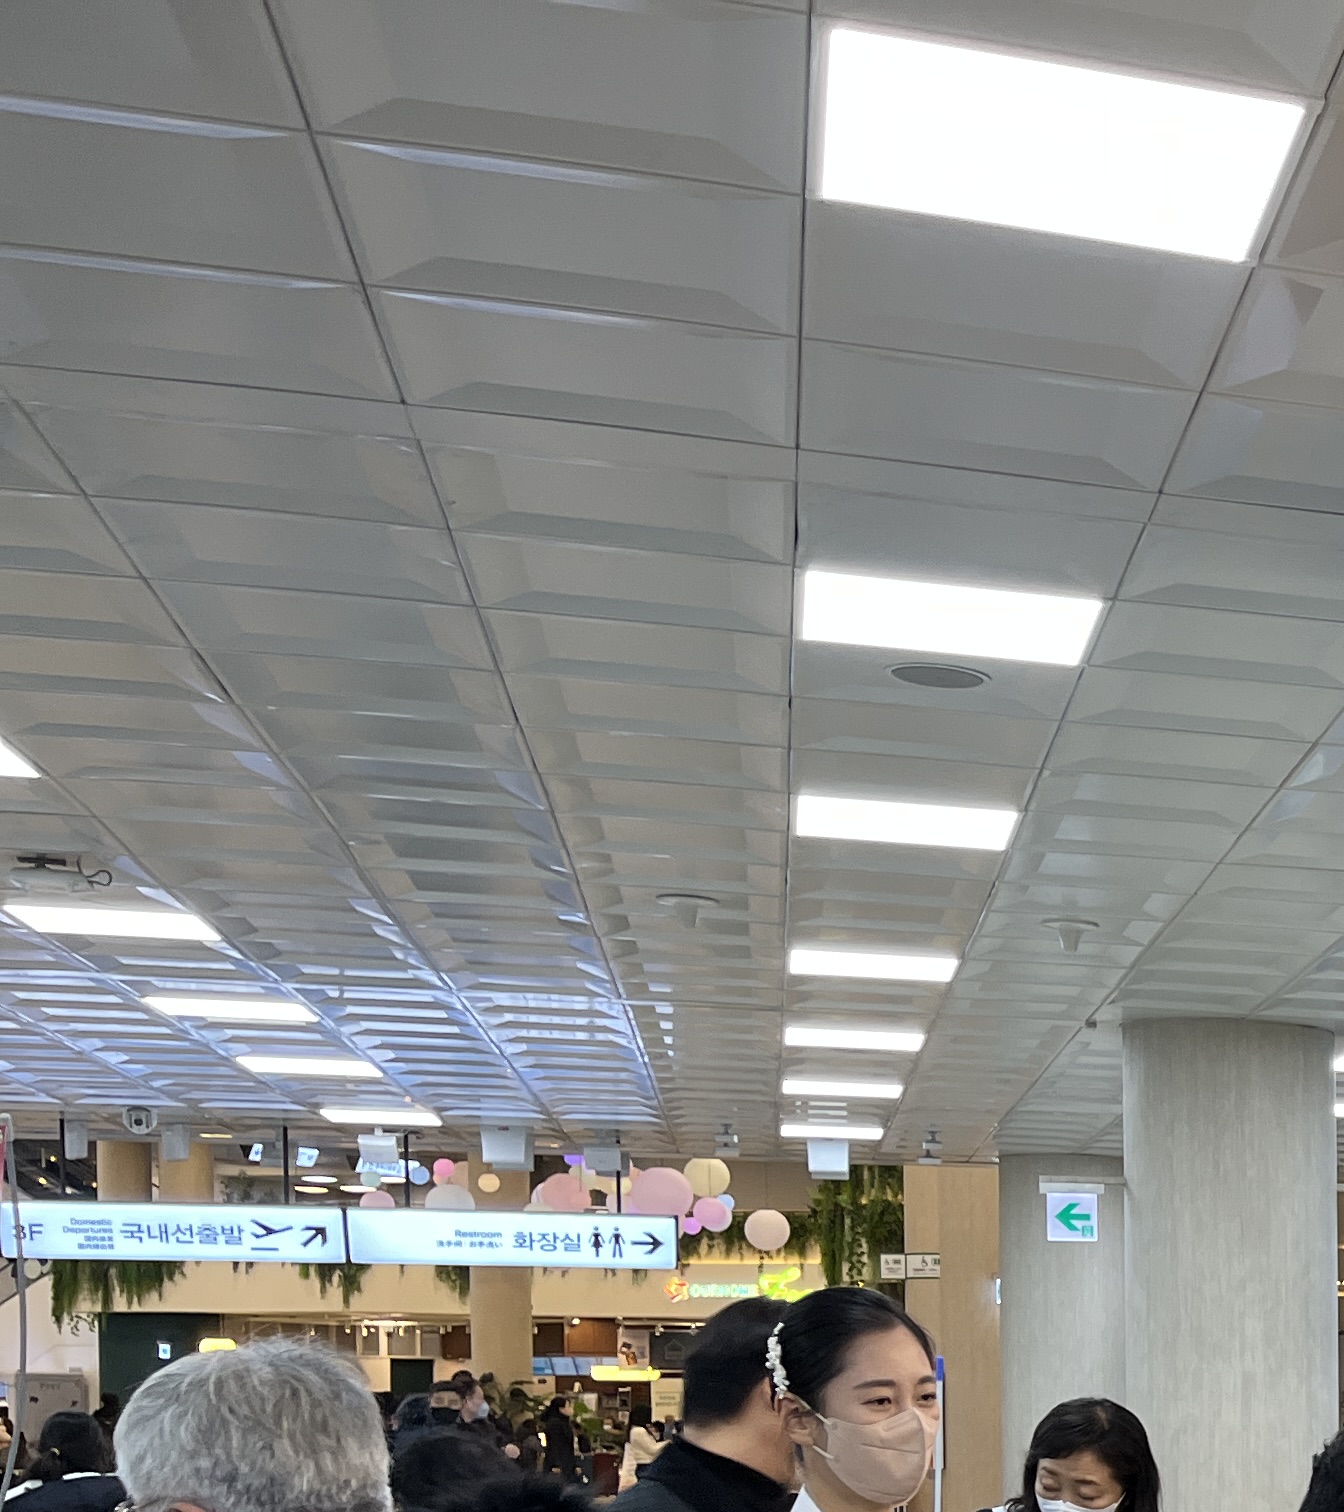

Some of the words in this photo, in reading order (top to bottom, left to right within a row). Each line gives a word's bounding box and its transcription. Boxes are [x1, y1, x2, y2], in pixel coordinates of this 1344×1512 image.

[119, 1222, 244, 1246] 국내선출발
[454, 1229, 503, 1238] Restroom
[512, 1231, 582, 1252] 화장실
